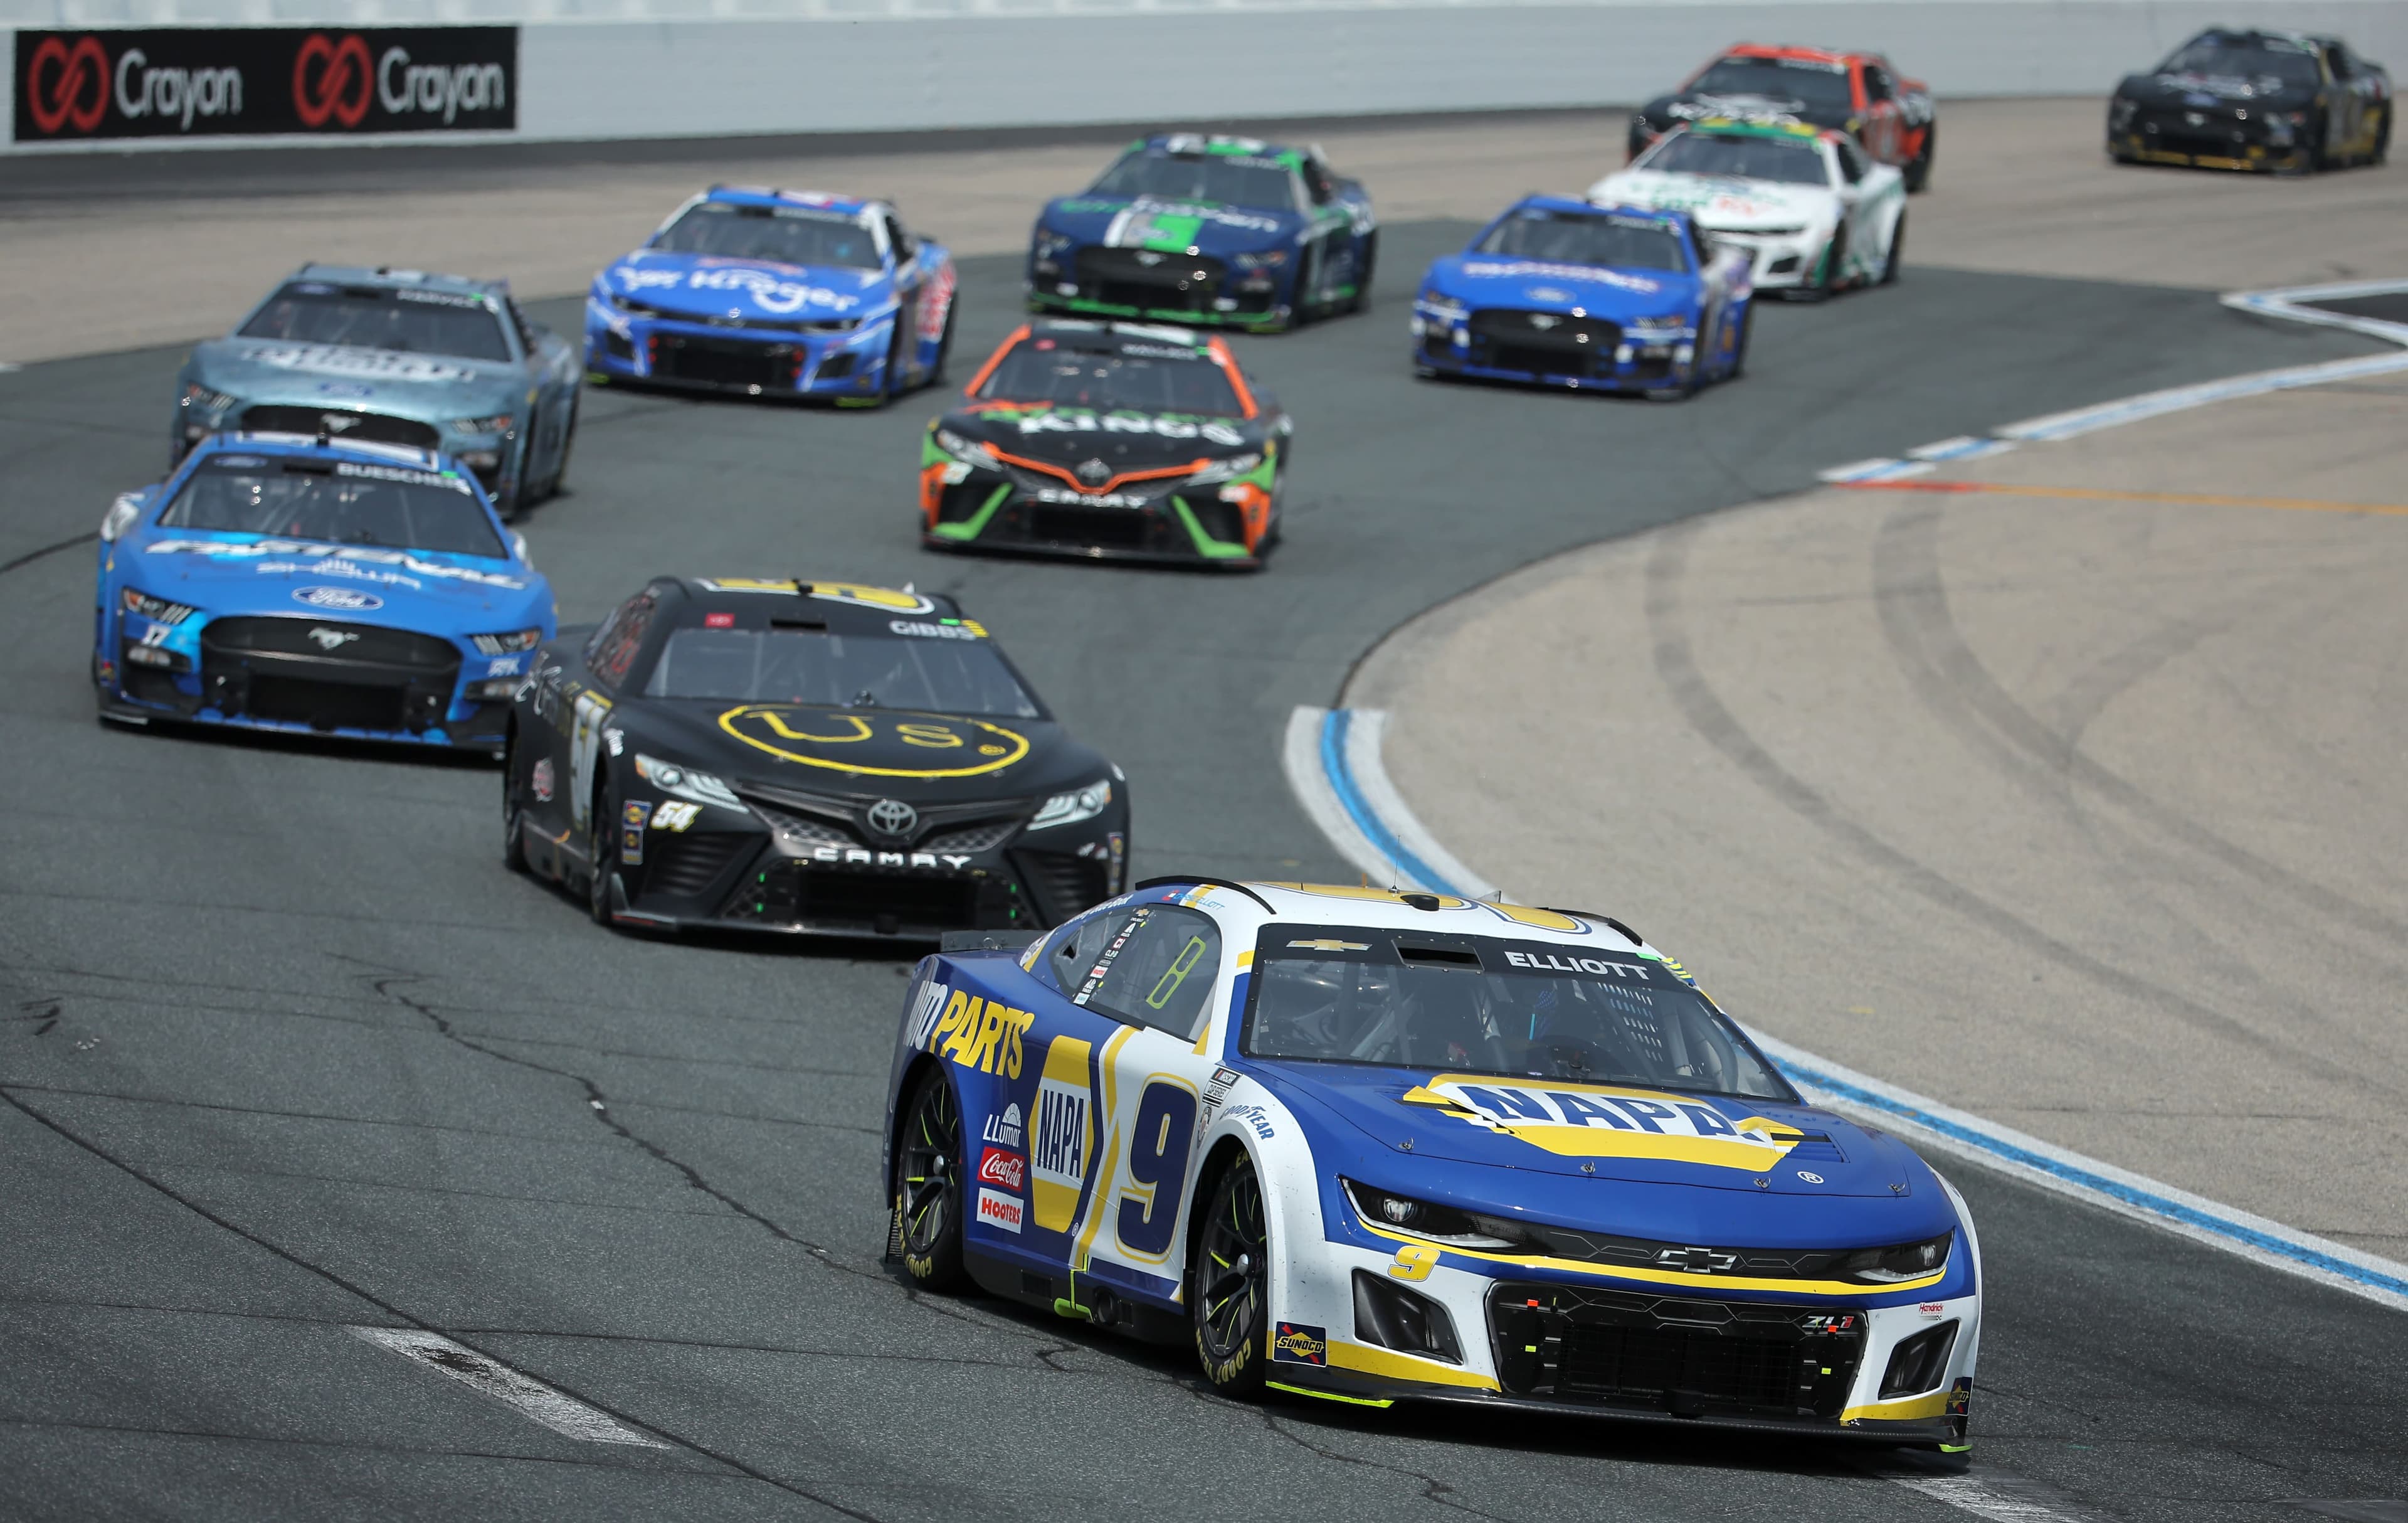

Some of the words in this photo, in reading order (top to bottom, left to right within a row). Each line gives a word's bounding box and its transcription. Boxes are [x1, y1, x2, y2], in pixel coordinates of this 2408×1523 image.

[115, 48, 243, 130] Crayon
[379, 46, 504, 125] Crayon
[889, 620, 977, 640] GIBBS
[650, 800, 704, 833] 54
[814, 847, 971, 870] CAMRY
[1505, 951, 1650, 980] ELLIOTT
[929, 989, 1035, 1080] PARTS
[983, 1113, 1021, 1148] LLumar
[1456, 1086, 1767, 1144] NAPA
[1037, 1089, 1084, 1178] NAPA
[1115, 1075, 1199, 1261] 9
[981, 1197, 1020, 1225] HOOTERS
[1387, 1244, 1442, 1283] 9
[1919, 1303, 1944, 1315] Hendrick
[1277, 1336, 1324, 1353] SUNOCO
